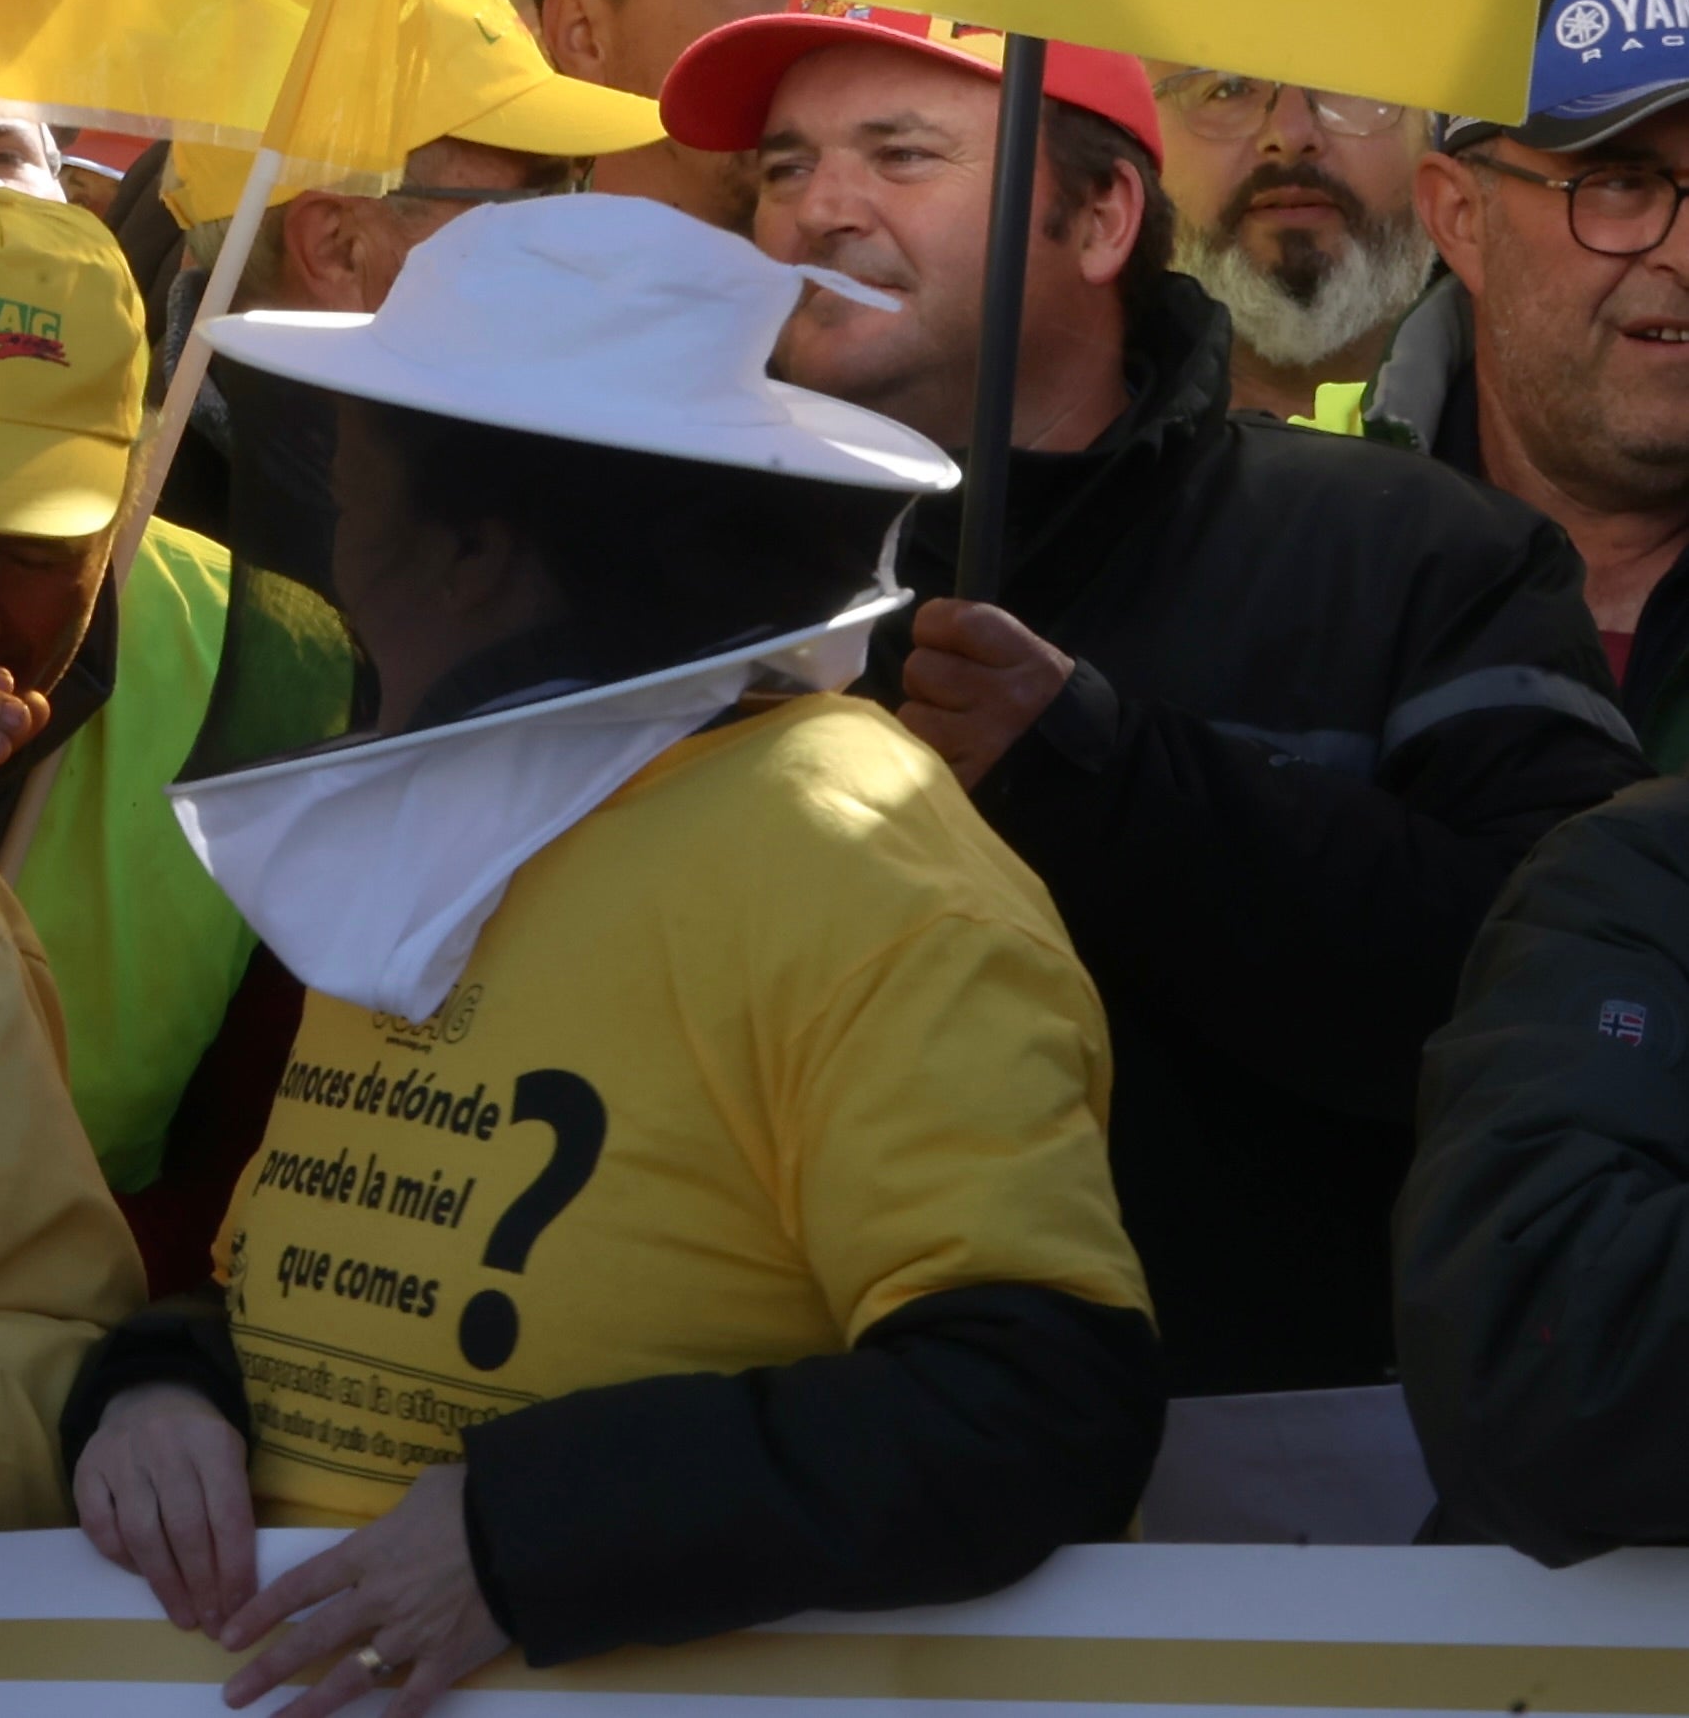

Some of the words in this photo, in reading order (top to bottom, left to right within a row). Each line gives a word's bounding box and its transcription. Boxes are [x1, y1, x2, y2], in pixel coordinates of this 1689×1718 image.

[353, 1061, 386, 1115] de
[387, 1068, 502, 1142] dónde
[252, 1147, 358, 1205] procede
[357, 1152, 387, 1210] la
[389, 1168, 477, 1229] miel
[277, 1244, 331, 1299] que
[333, 1257, 440, 1318] comes
